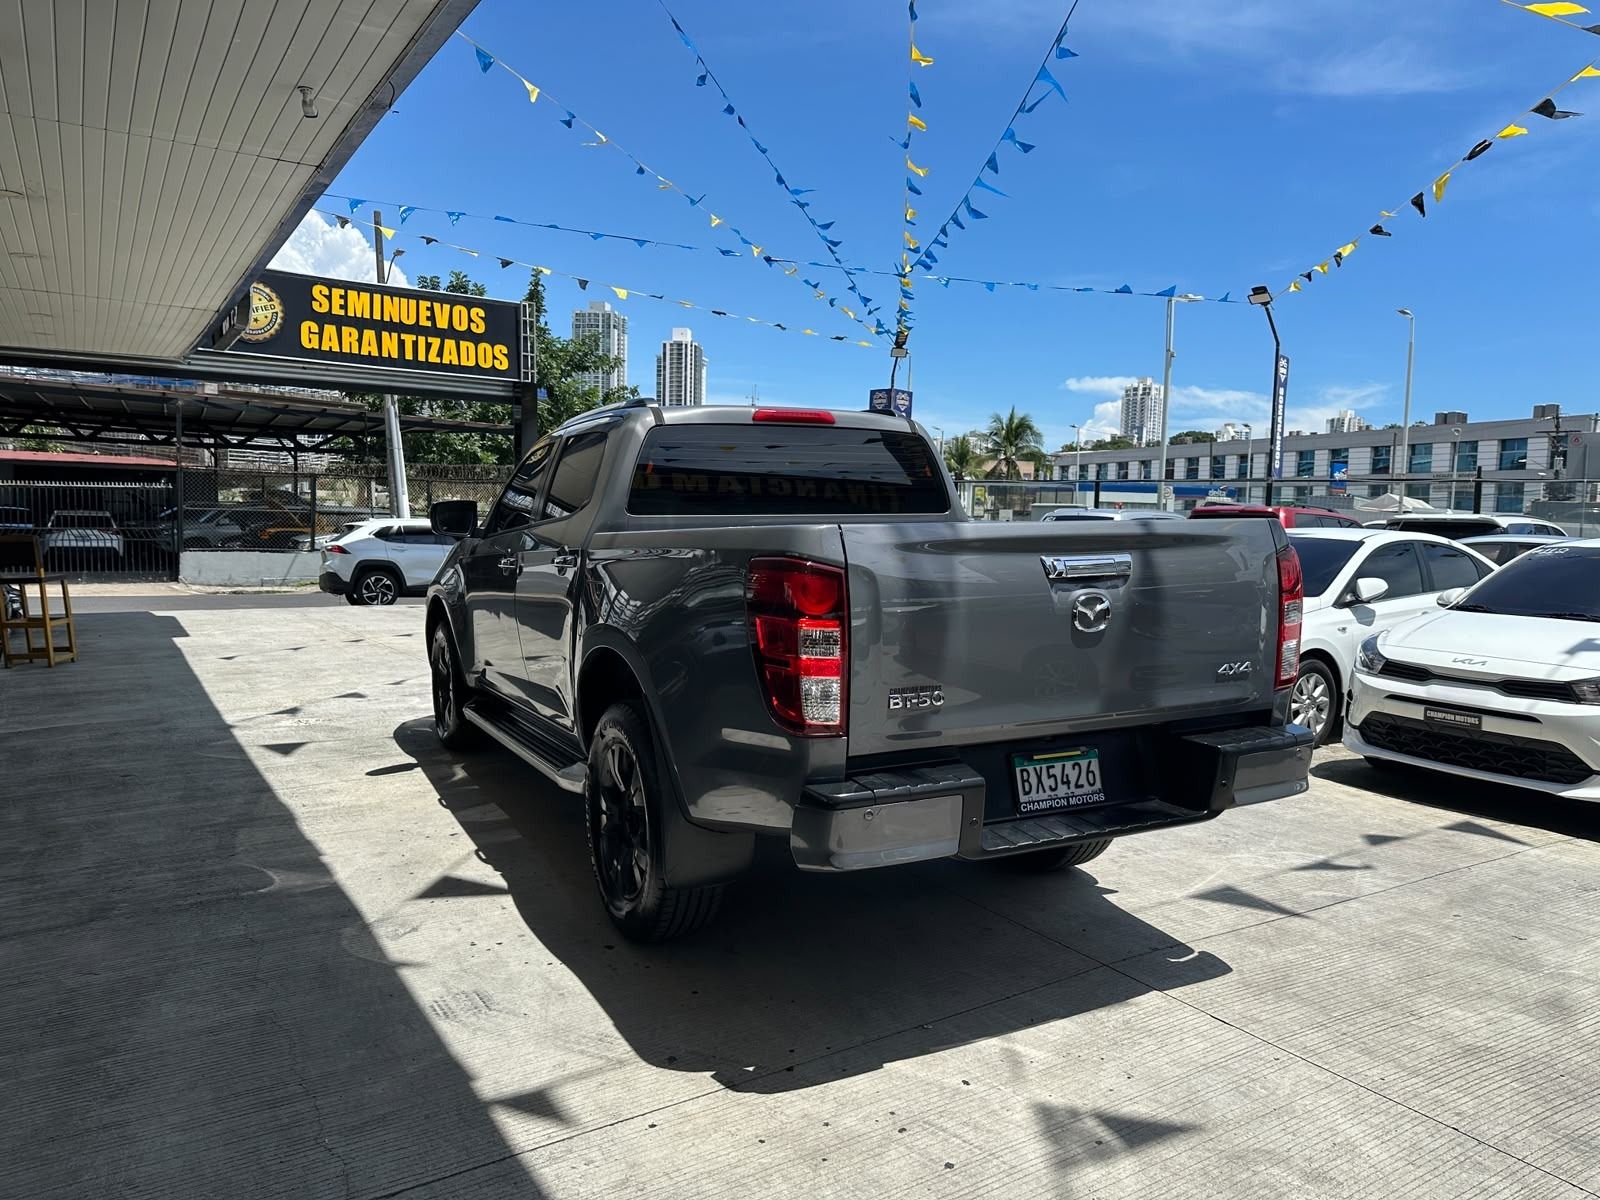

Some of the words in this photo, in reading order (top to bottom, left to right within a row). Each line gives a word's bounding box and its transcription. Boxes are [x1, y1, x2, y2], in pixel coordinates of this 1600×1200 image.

[252, 303, 276, 314] IFIED
[311, 284, 486, 335] SEMINUEVOS
[300, 320, 510, 371] GARANTIZADOS
[1273, 387, 1285, 469] COMPRAMOS
[888, 690, 945, 709] BT-50
[1426, 710, 1455, 721] CHAMPION
[1455, 715, 1479, 725] MOTORS
[1019, 760, 1097, 796] BX5426
[1020, 797, 1068, 812] CHAMPION
[1069, 792, 1105, 806] MOTORS
